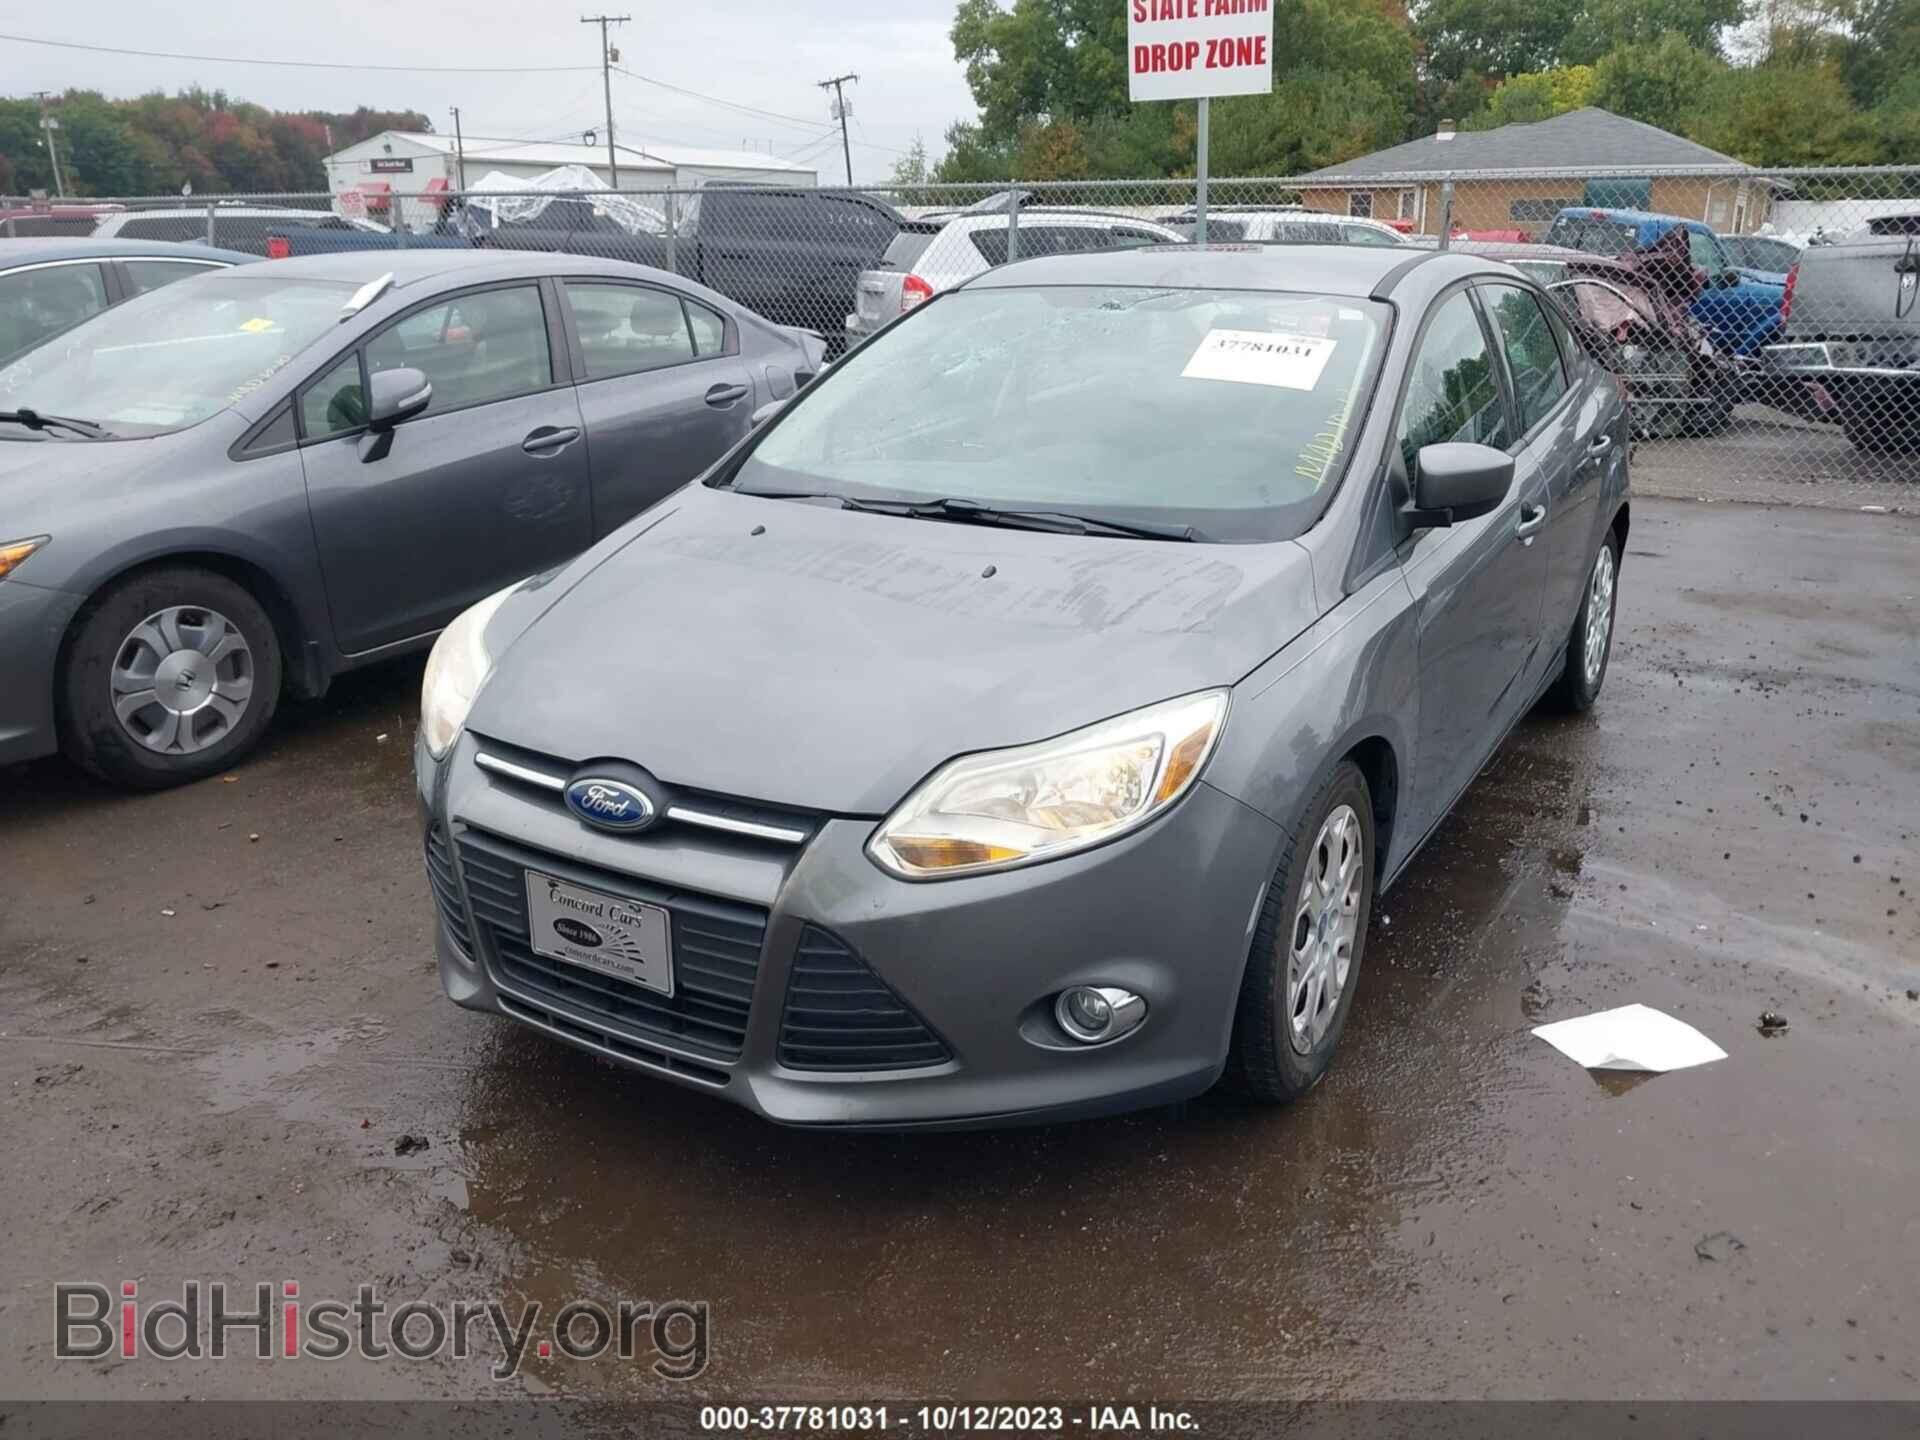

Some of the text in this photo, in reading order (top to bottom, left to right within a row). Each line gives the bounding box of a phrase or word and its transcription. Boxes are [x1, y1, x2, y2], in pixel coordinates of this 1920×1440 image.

[1134, 0, 1198, 23] STATE
[1134, 36, 1266, 73] DROP ZONE
[581, 785, 630, 817] Ford
[550, 888, 642, 928] Concord Cars
